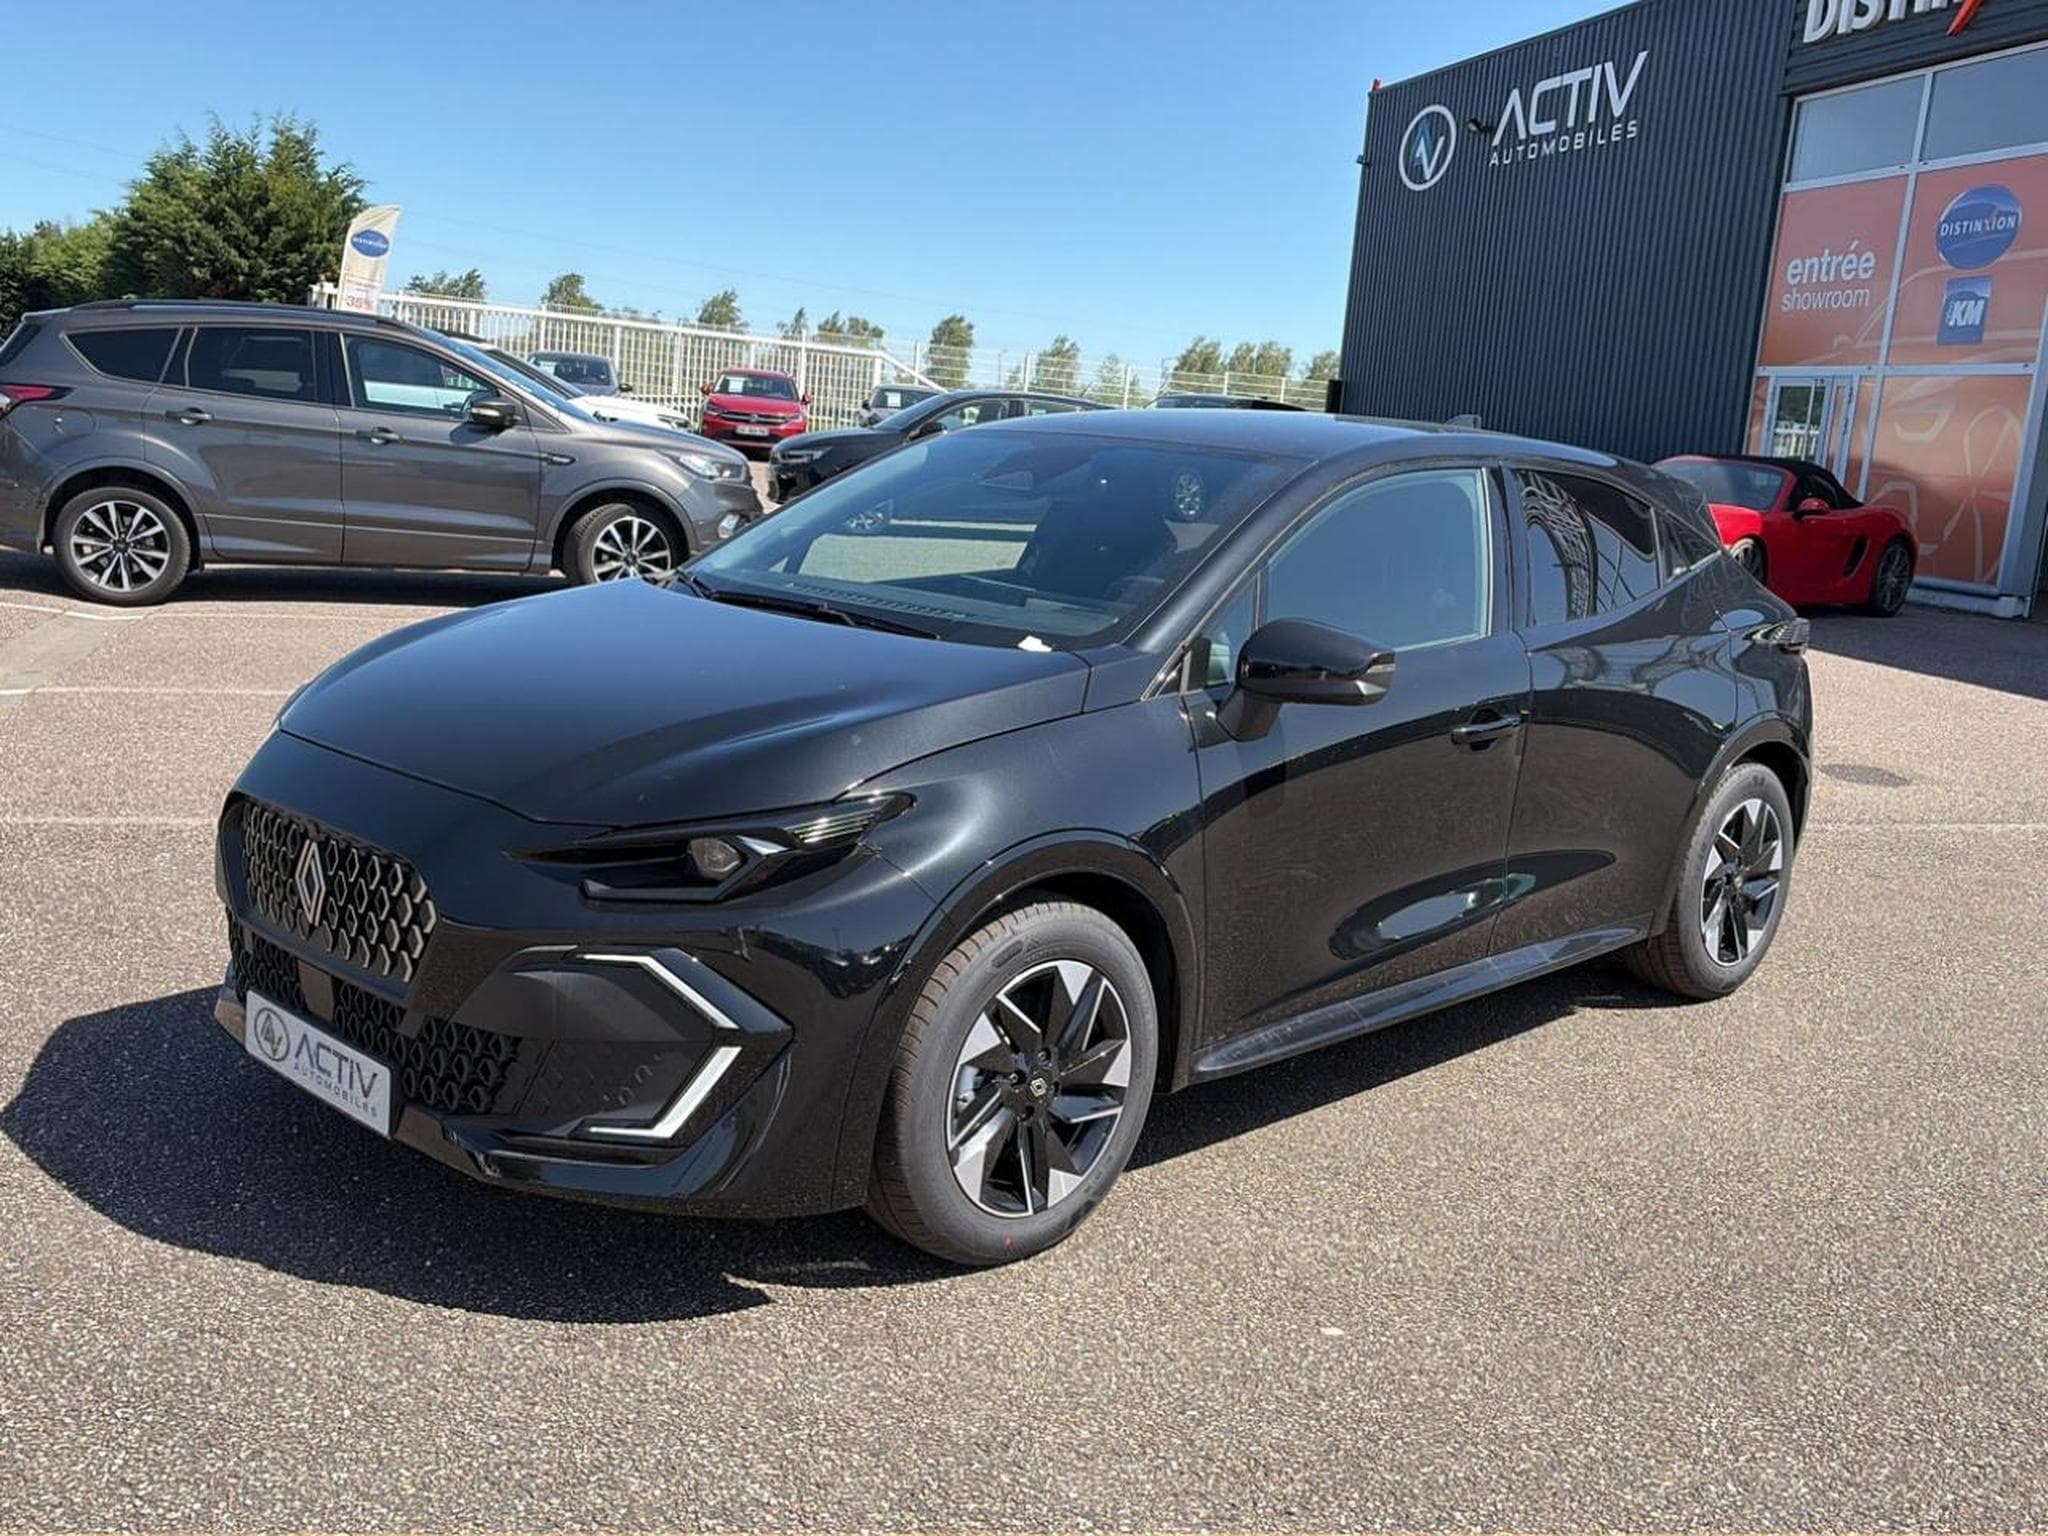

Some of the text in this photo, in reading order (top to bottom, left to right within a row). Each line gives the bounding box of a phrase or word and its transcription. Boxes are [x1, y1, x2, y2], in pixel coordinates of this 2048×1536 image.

[1491, 51, 1648, 147] ACTIV
[1489, 120, 1637, 167] AUTOMOBILES
[1787, 240, 1876, 285] entrée
[1781, 287, 1870, 312] showroom
[294, 1062, 377, 1117] AUTOMOBILES
[295, 1033, 377, 1099] ACTIV
